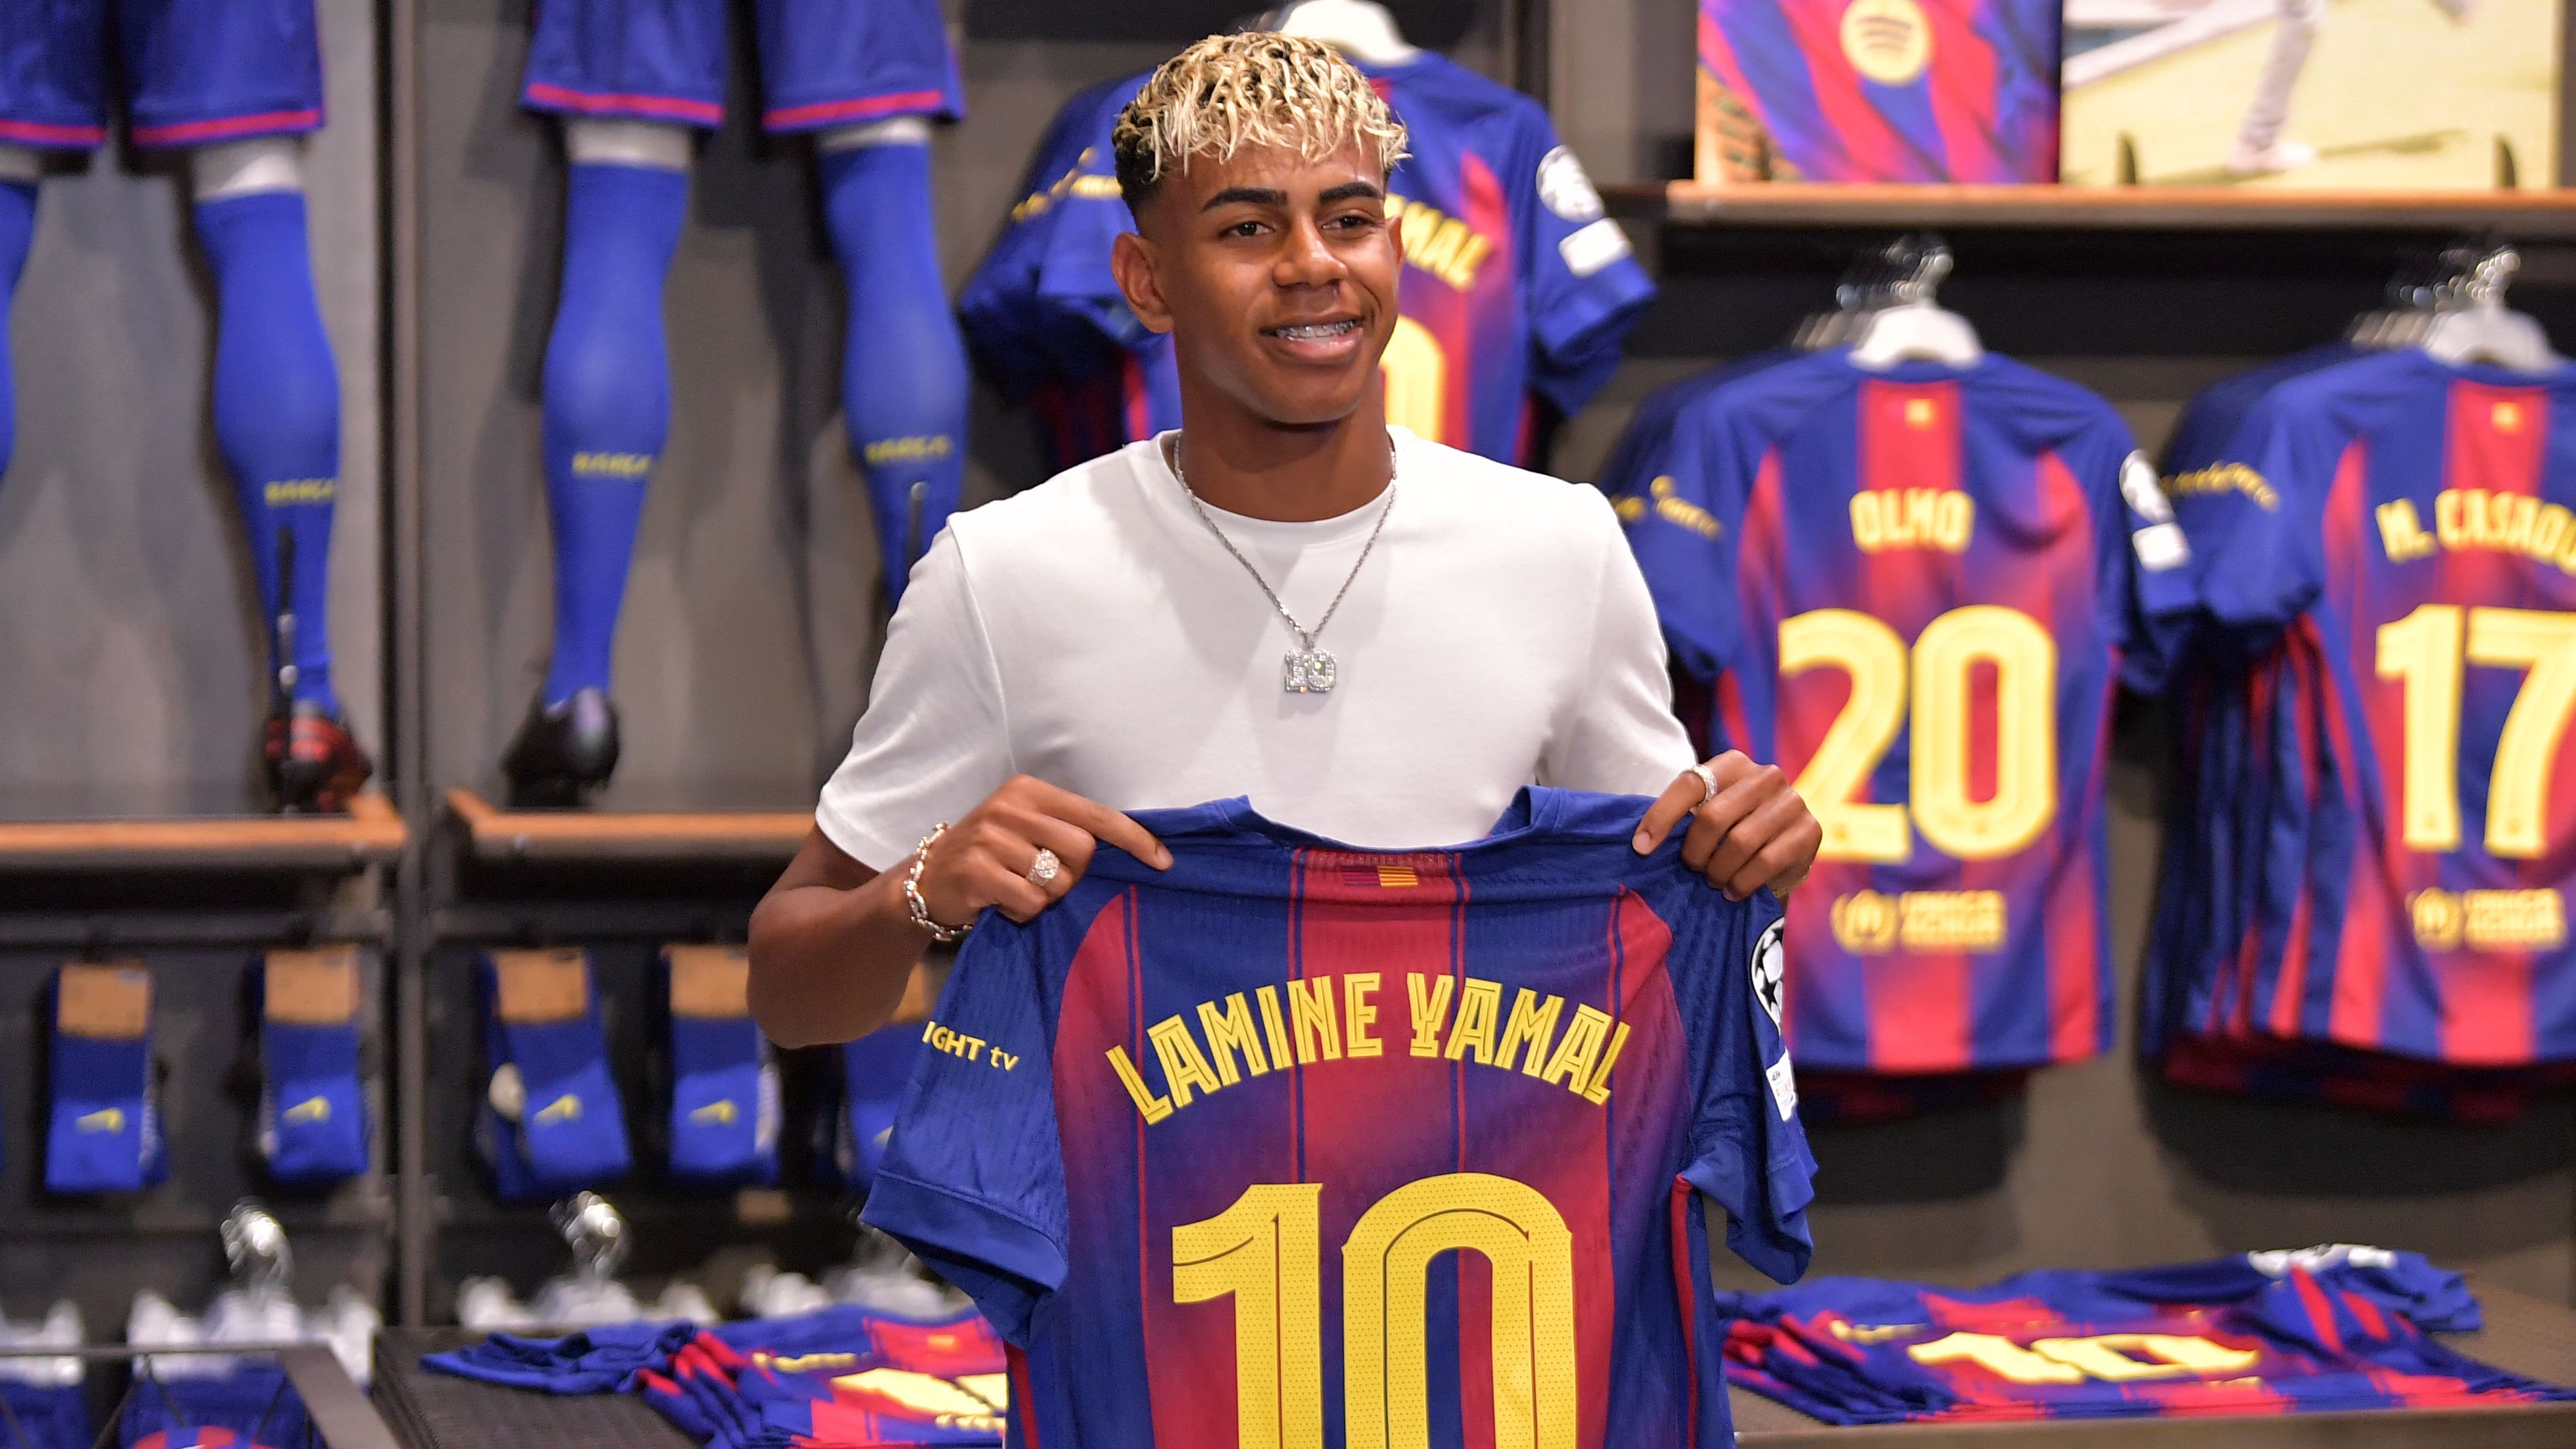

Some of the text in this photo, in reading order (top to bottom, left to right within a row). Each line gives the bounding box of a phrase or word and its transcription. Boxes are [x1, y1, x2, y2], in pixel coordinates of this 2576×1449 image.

[1849, 488, 1975, 552] OLMO
[1778, 605, 2058, 861] 20
[2376, 605, 2576, 857] 17
[990, 1046, 1020, 1071] tv
[1105, 972, 1631, 1125] LAMINE YAMAL
[1172, 1172, 1576, 1449] 10
